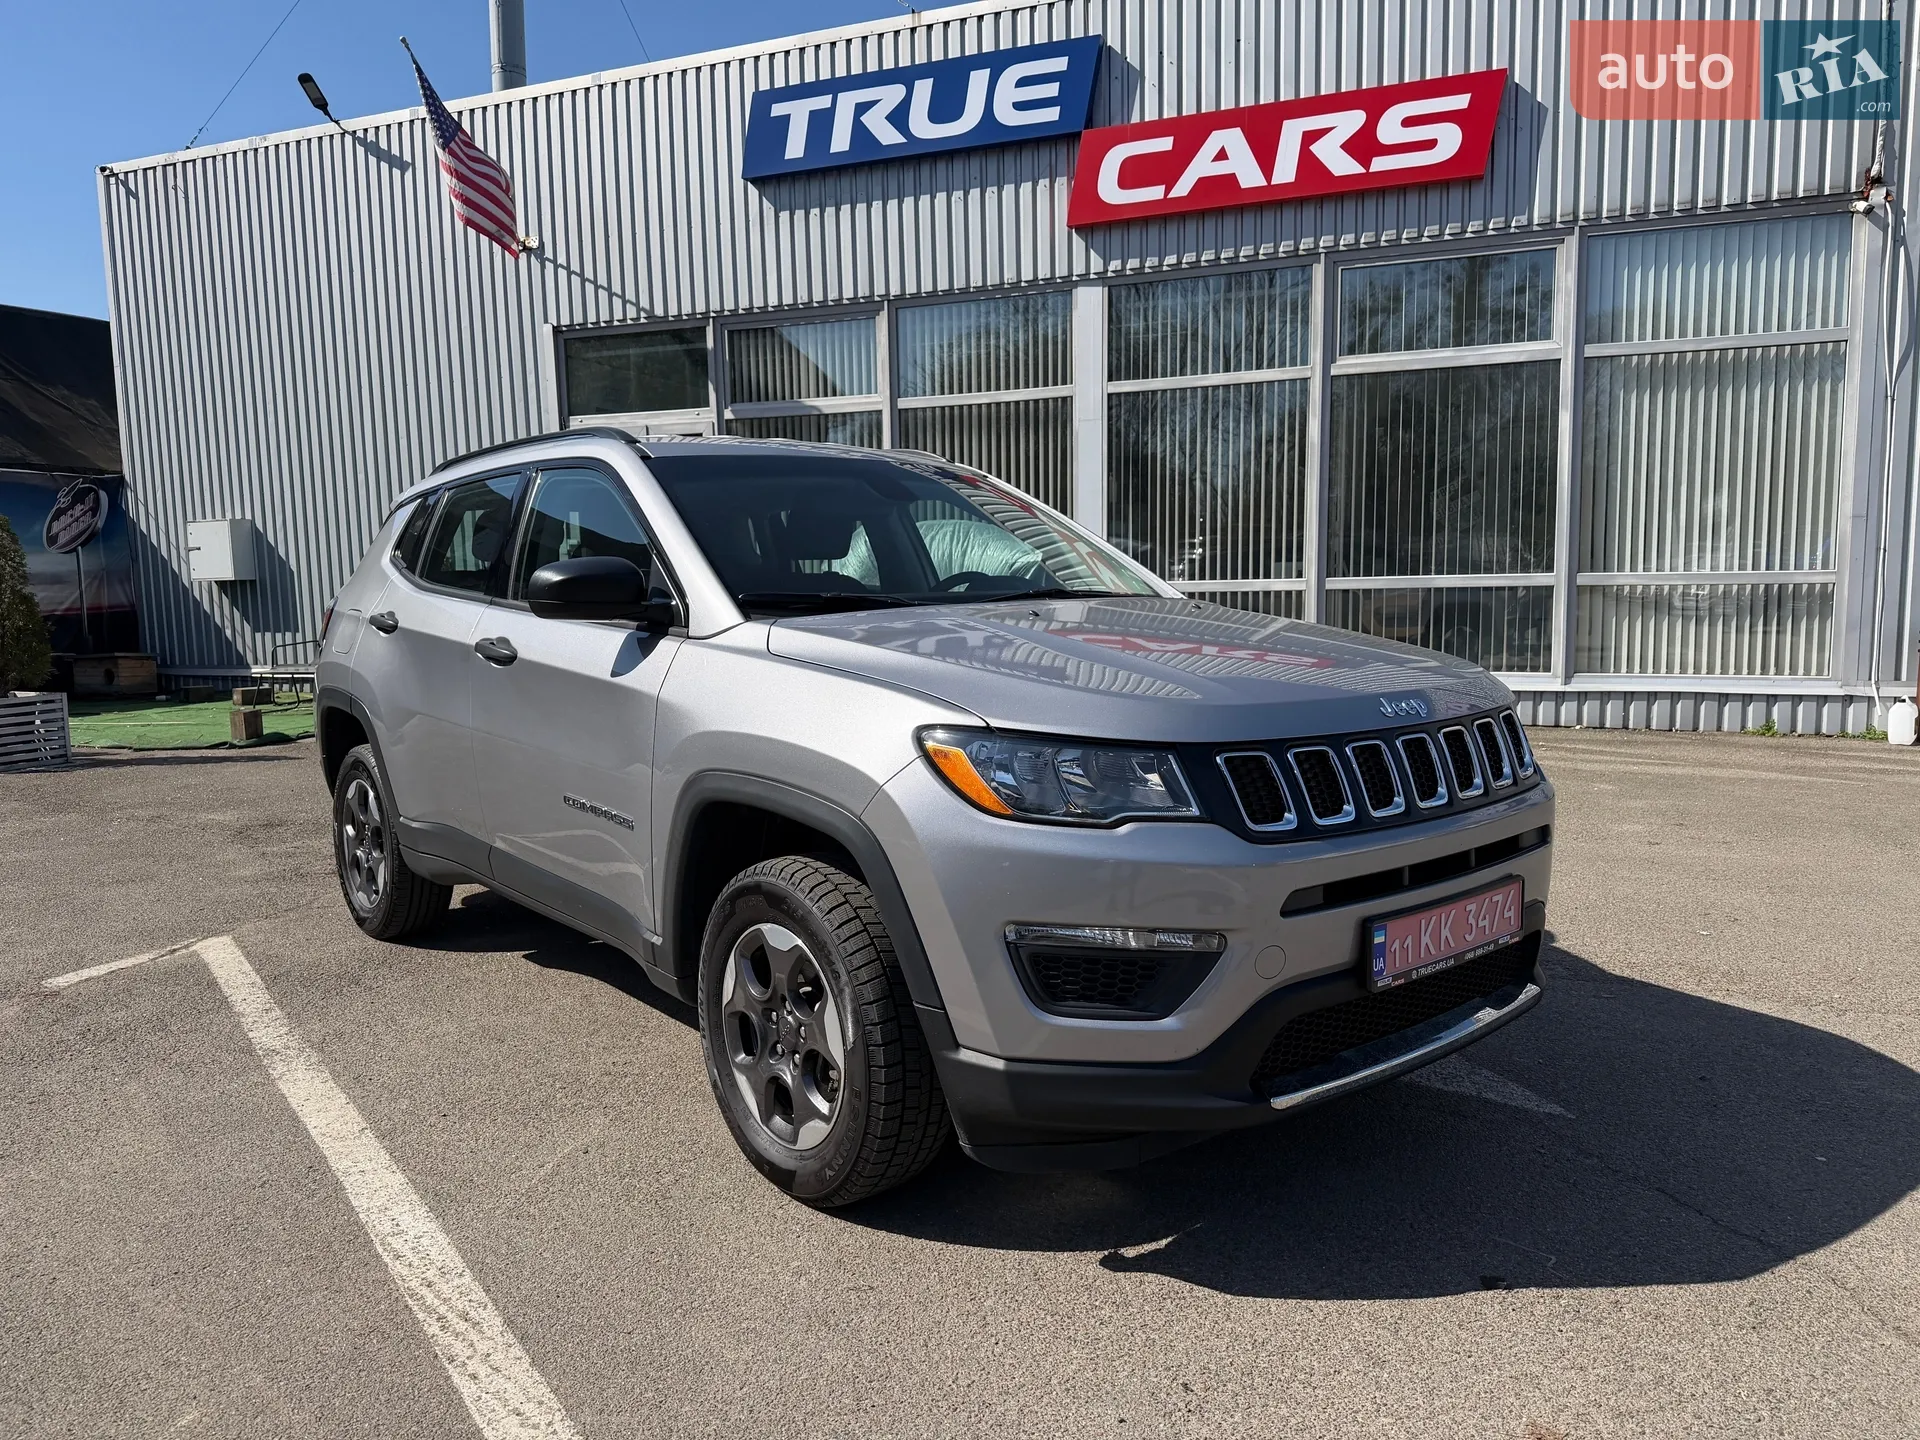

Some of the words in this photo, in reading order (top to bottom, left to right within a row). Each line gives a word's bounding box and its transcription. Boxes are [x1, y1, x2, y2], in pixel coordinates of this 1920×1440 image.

[770, 56, 1069, 159] TRUE
[1096, 92, 1473, 205] CARS
[1379, 697, 1428, 717] Jeep
[563, 793, 634, 832] COMPASS
[1390, 935, 1412, 968] 11
[1420, 909, 1456, 958] KK
[1464, 889, 1515, 942] 3474
[1373, 957, 1385, 971] UA
